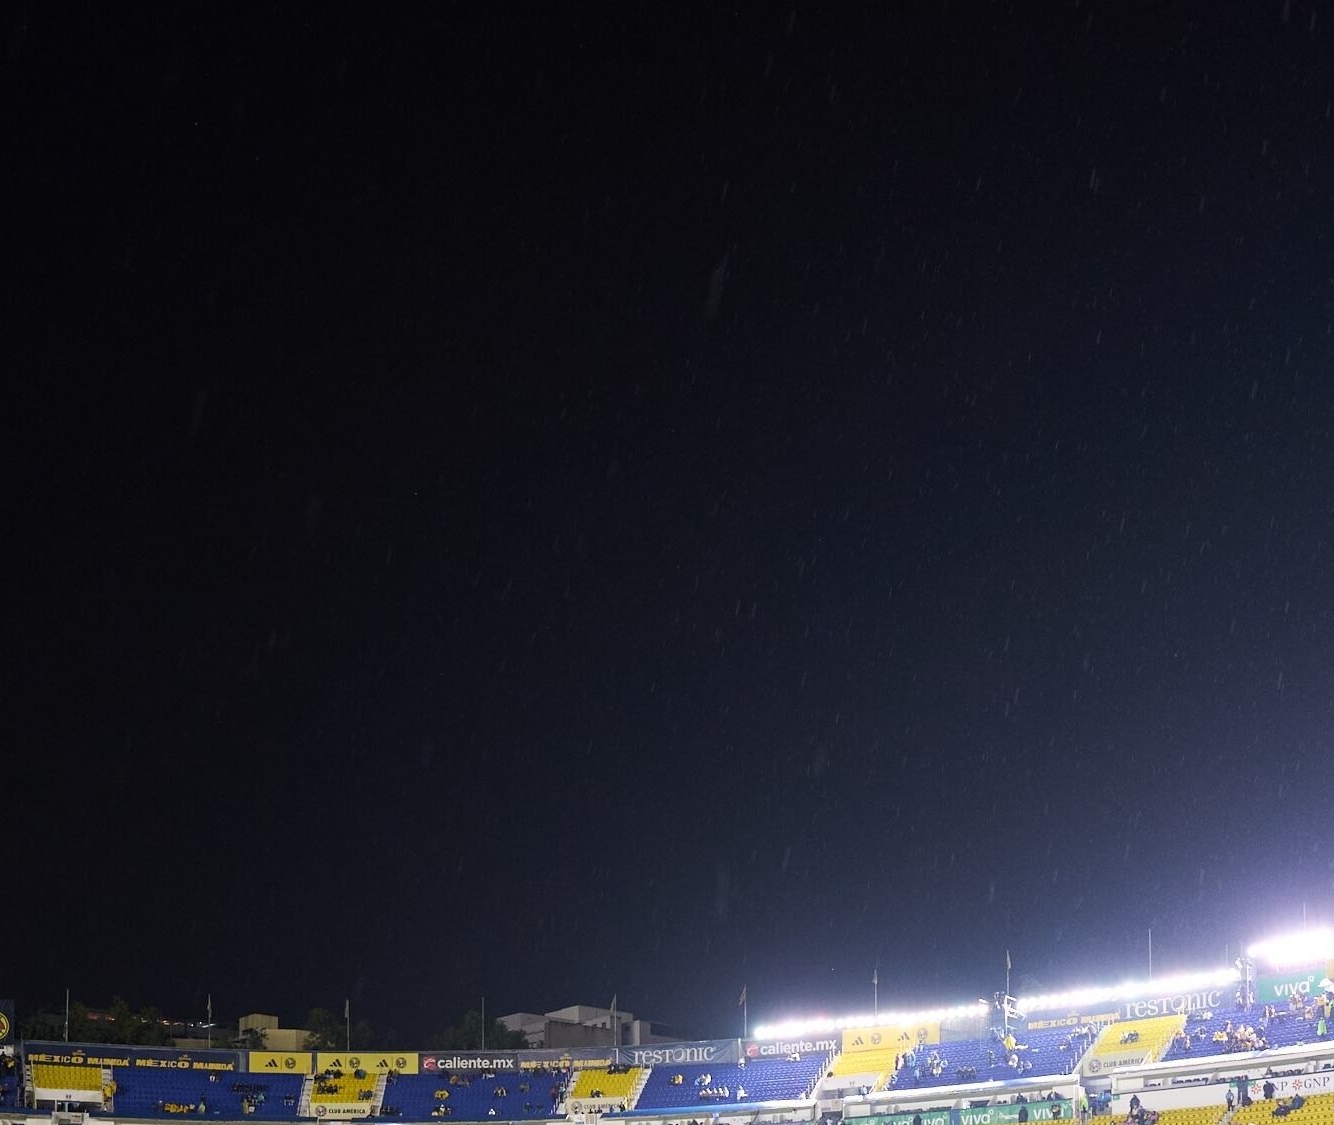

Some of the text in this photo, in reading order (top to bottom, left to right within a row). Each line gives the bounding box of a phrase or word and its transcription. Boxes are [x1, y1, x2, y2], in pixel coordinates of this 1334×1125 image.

[760, 1039, 837, 1055] caliente.mx
[438, 1056, 514, 1069] caliente.mx
[1103, 1058, 1117, 1069] CLUB
[1272, 1081, 1288, 1091] NP
[1304, 1077, 1330, 1088] GNP
[961, 1113, 991, 1125] viva
